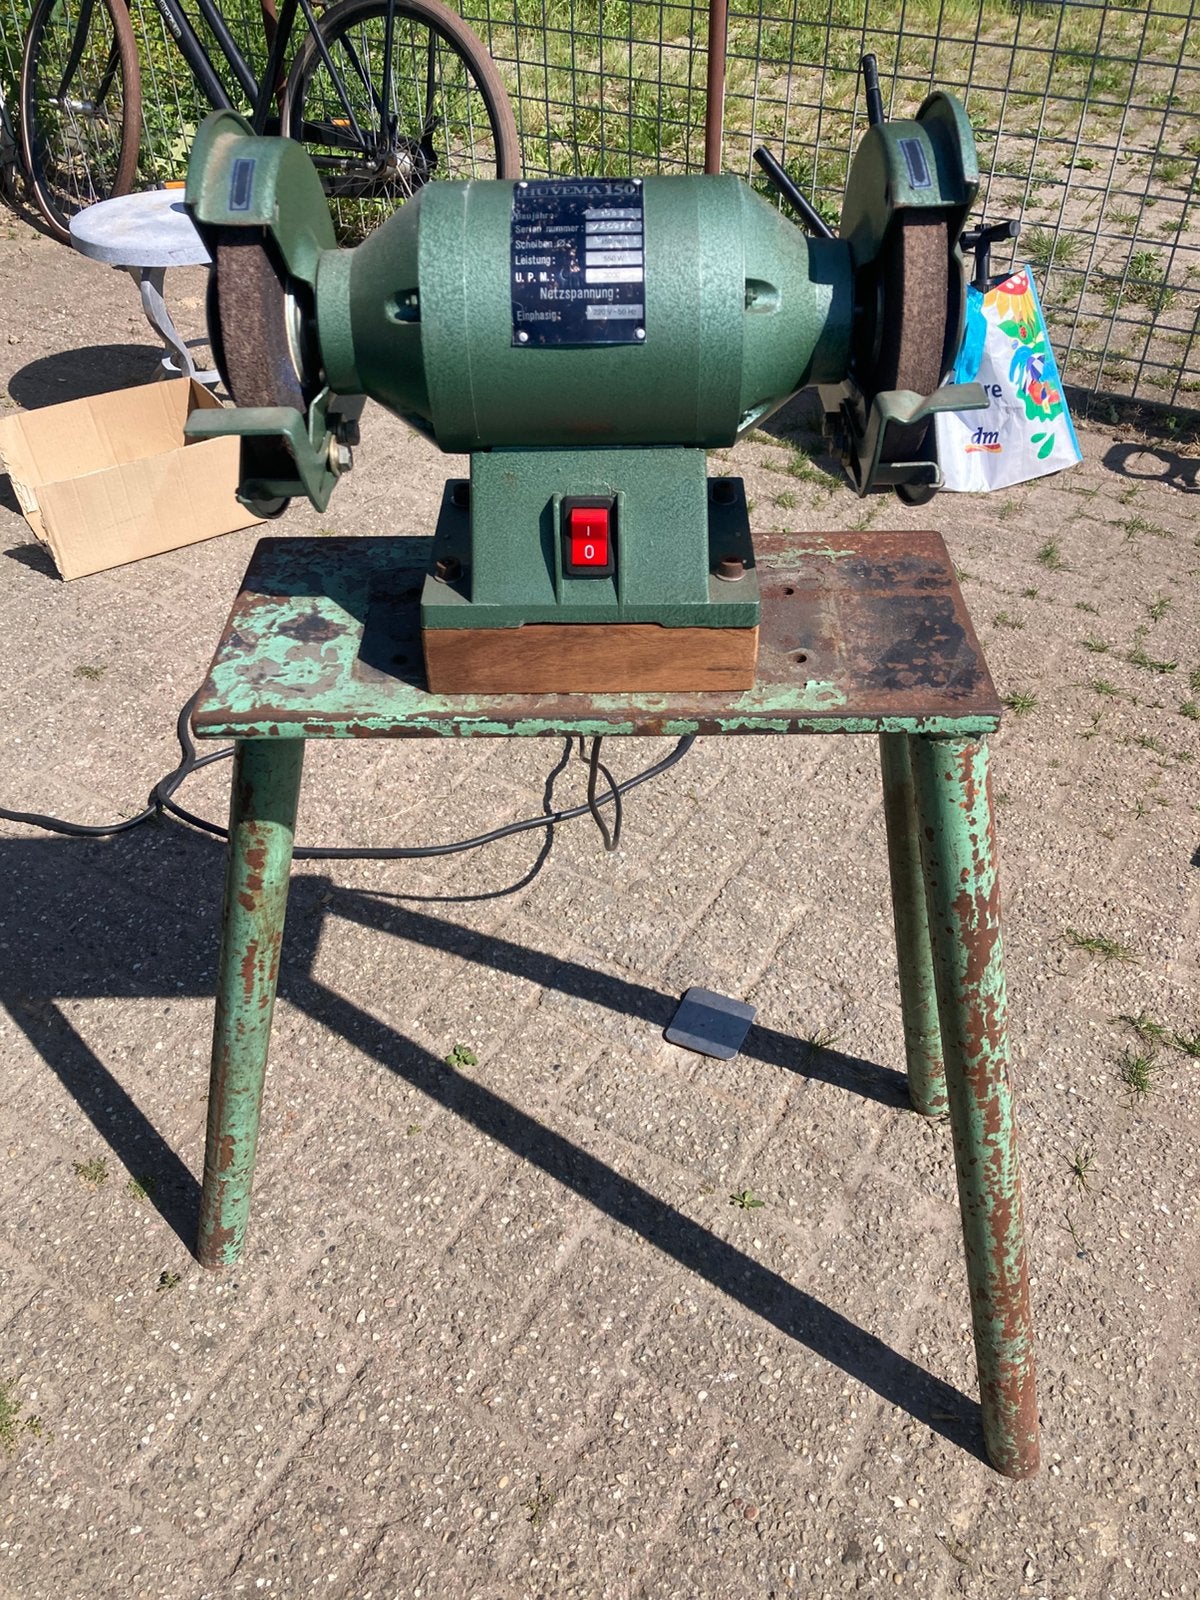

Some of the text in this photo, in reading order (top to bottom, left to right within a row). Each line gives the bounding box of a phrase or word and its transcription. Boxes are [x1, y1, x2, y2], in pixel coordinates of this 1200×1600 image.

[522, 183, 635, 196] HUVEMA 150
[515, 255, 555, 267] Leistung:
[540, 287, 619, 302] Netzspannung:
[516, 310, 562, 322] Einphasig:
[971, 426, 999, 445] dm
